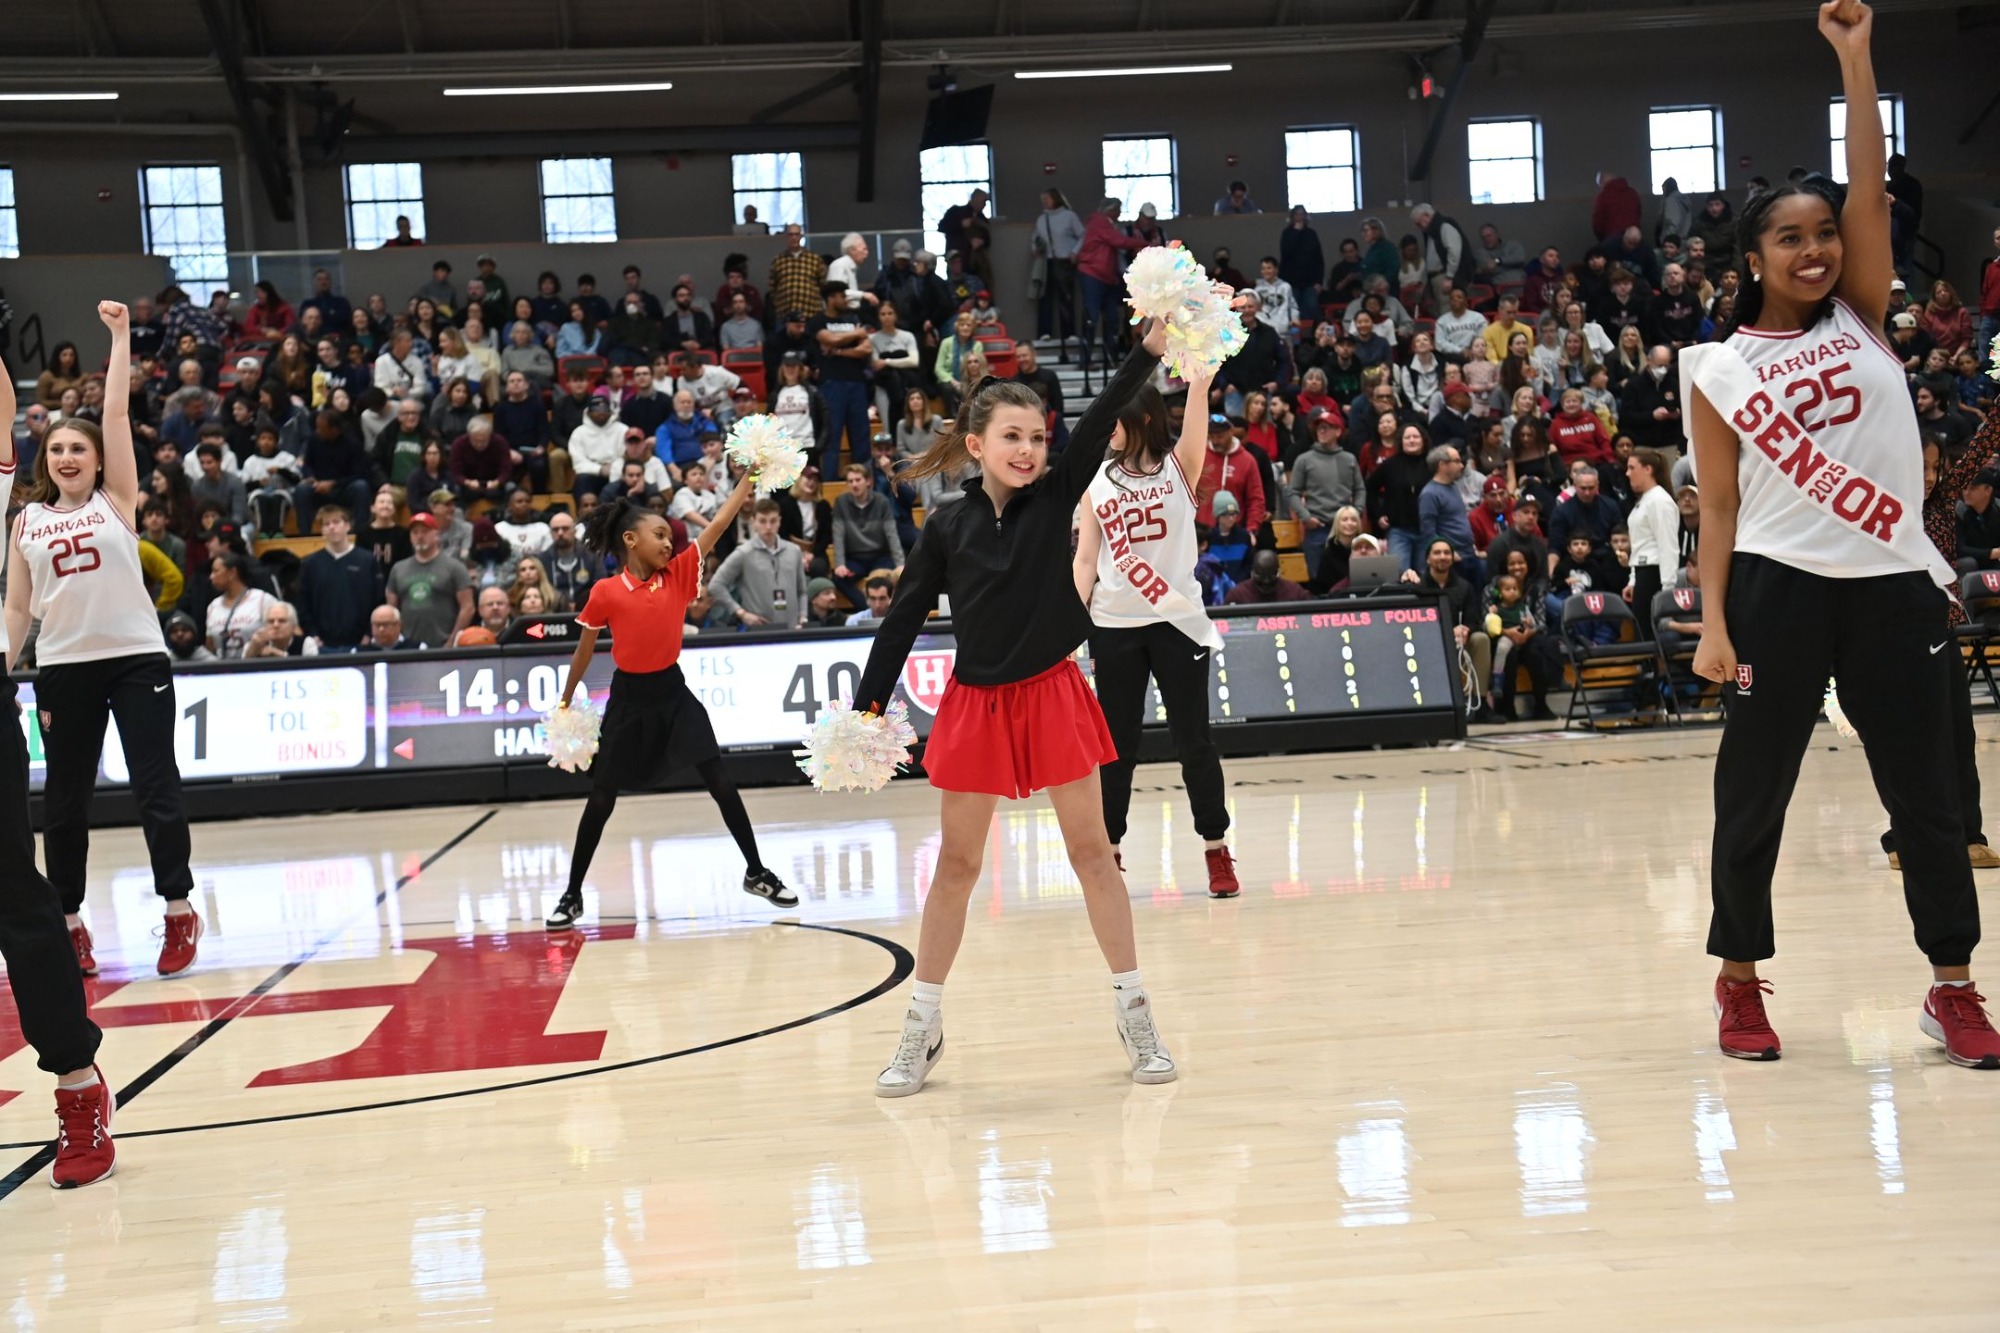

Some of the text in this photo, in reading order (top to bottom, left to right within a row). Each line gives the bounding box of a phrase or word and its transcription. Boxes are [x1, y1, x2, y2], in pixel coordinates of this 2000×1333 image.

[1785, 362, 1861, 433] 25
[1118, 480, 1174, 504] ARVARD
[31, 512, 105, 541] HARVARD
[1124, 503, 1167, 543] 25
[48, 532, 101, 578] 25
[543, 624, 567, 636] POSS
[1256, 616, 1299, 631] ASST.
[1311, 612, 1371, 628] STEALS
[1384, 608, 1437, 624] FOULS
[1275, 626, 1413, 648] 2 1 1
[700, 656, 734, 675] FLS
[914, 658, 945, 695] H
[271, 680, 307, 699] FLS
[699, 687, 737, 707] TOL
[783, 661, 861, 724] 40
[1346, 679, 1357, 694] 2
[267, 711, 310, 732] TOL
[279, 740, 347, 762] BONUS
